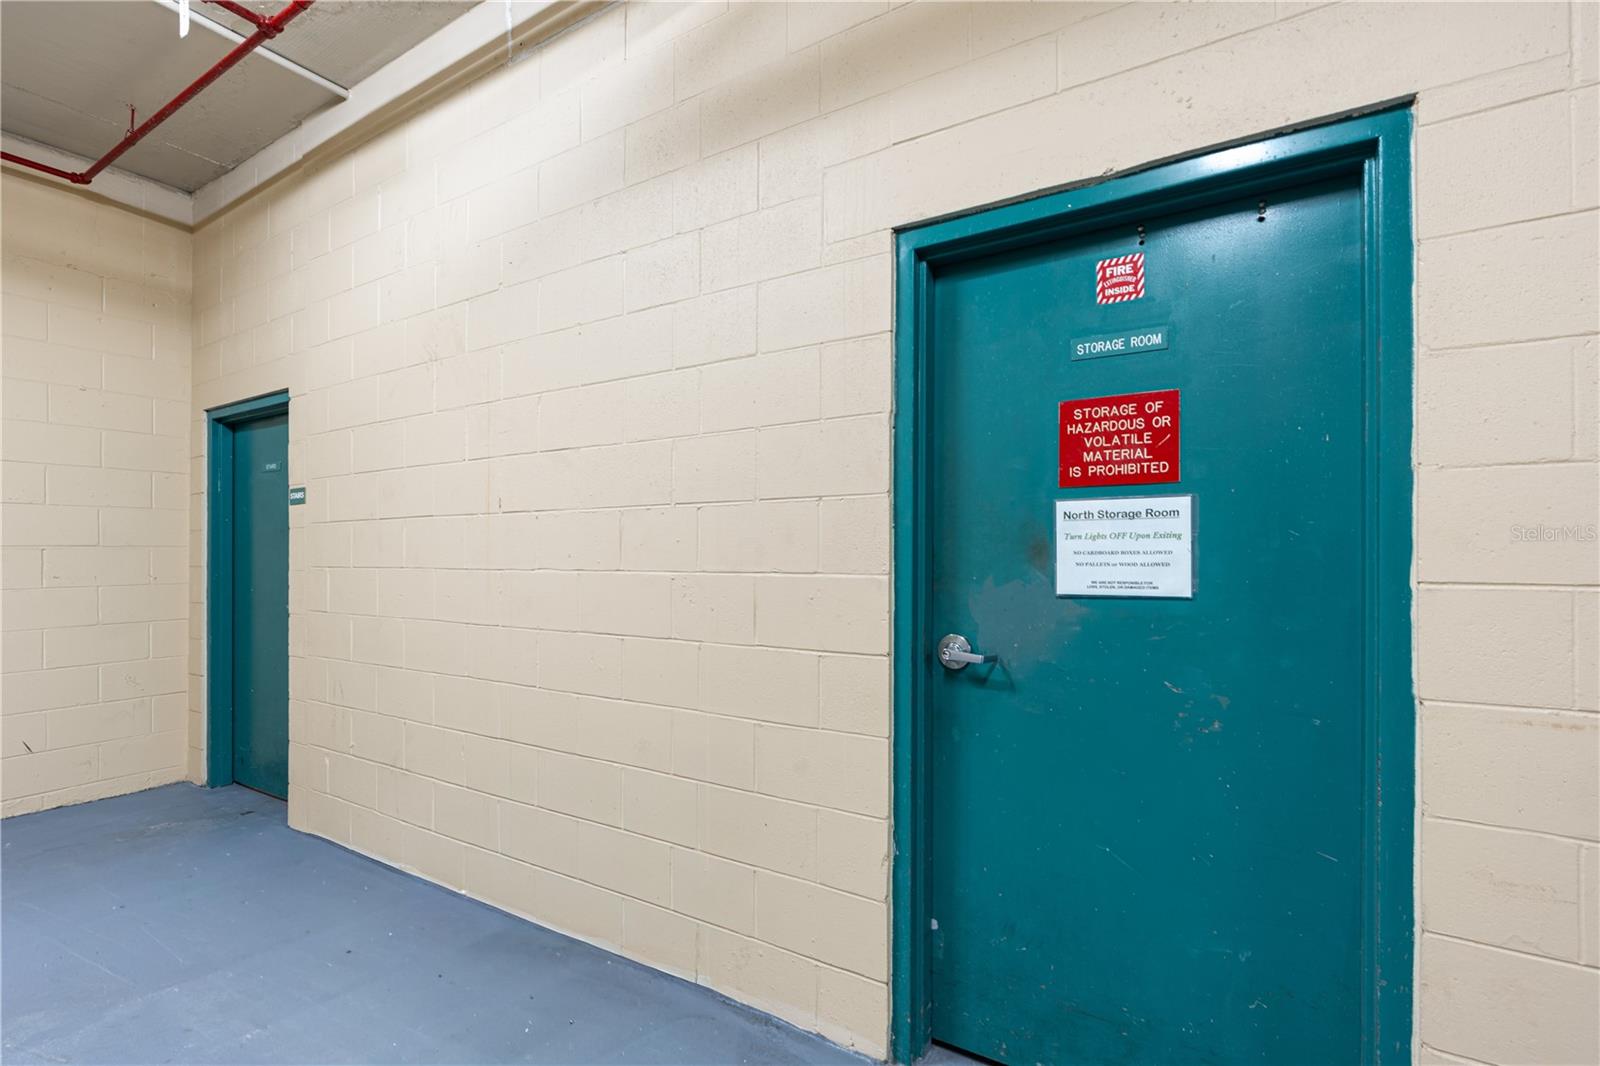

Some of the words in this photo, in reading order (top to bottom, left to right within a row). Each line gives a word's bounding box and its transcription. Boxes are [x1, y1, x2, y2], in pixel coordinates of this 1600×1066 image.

[1106, 264, 1134, 278] FIRE
[1105, 284, 1135, 296] INSIDE
[1076, 338, 1125, 355] STORAGE
[1130, 333, 1162, 348] ROOM
[1074, 403, 1137, 420] STORAGE
[1144, 401, 1164, 413] OF
[1067, 418, 1145, 435] HAZARDOUS
[1152, 416, 1171, 428] OR
[1084, 432, 1152, 448] VOLATILE
[1083, 448, 1153, 463] MATERIAL
[1069, 466, 1082, 478] IS
[1088, 461, 1170, 477] PROHIBITED
[1063, 510, 1094, 520] North
[1098, 509, 1142, 521] Storage
[1145, 508, 1180, 518] Room
[1064, 533, 1082, 541] Turn
[1084, 532, 1107, 541] Lights
[1109, 532, 1128, 540] OFF
[1129, 532, 1150, 541] Upon
[1153, 531, 1182, 540] Exiting
